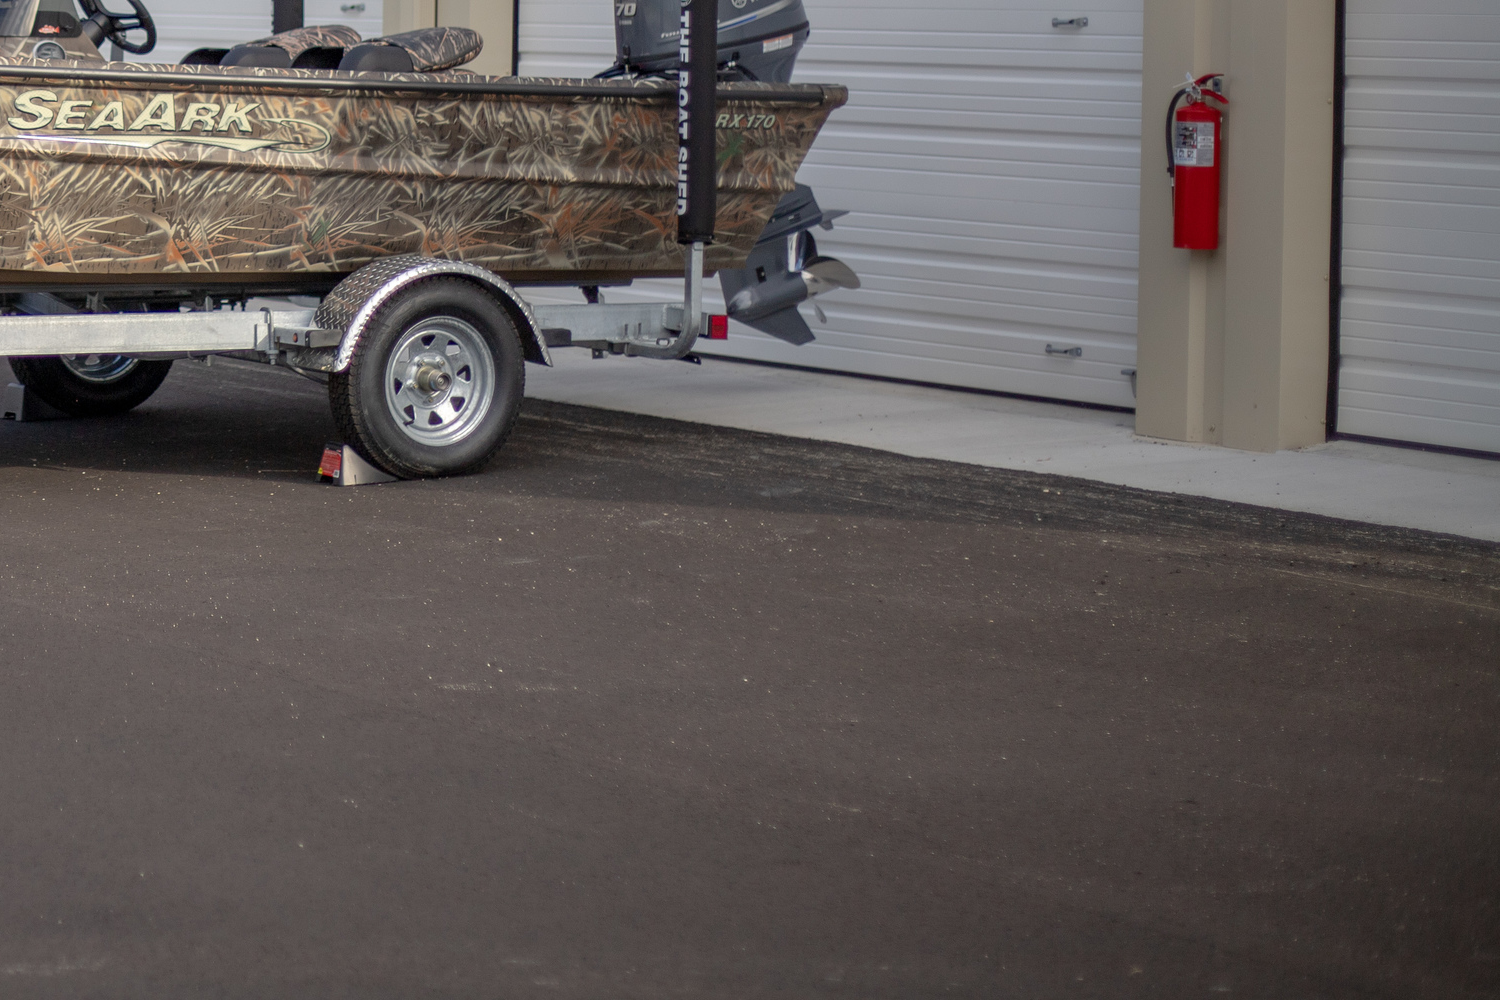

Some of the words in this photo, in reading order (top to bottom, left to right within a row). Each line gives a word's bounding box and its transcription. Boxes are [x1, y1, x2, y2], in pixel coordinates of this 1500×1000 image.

[615, 2, 637, 16] 70
[715, 114, 745, 129] RX
[746, 114, 776, 128] 170
